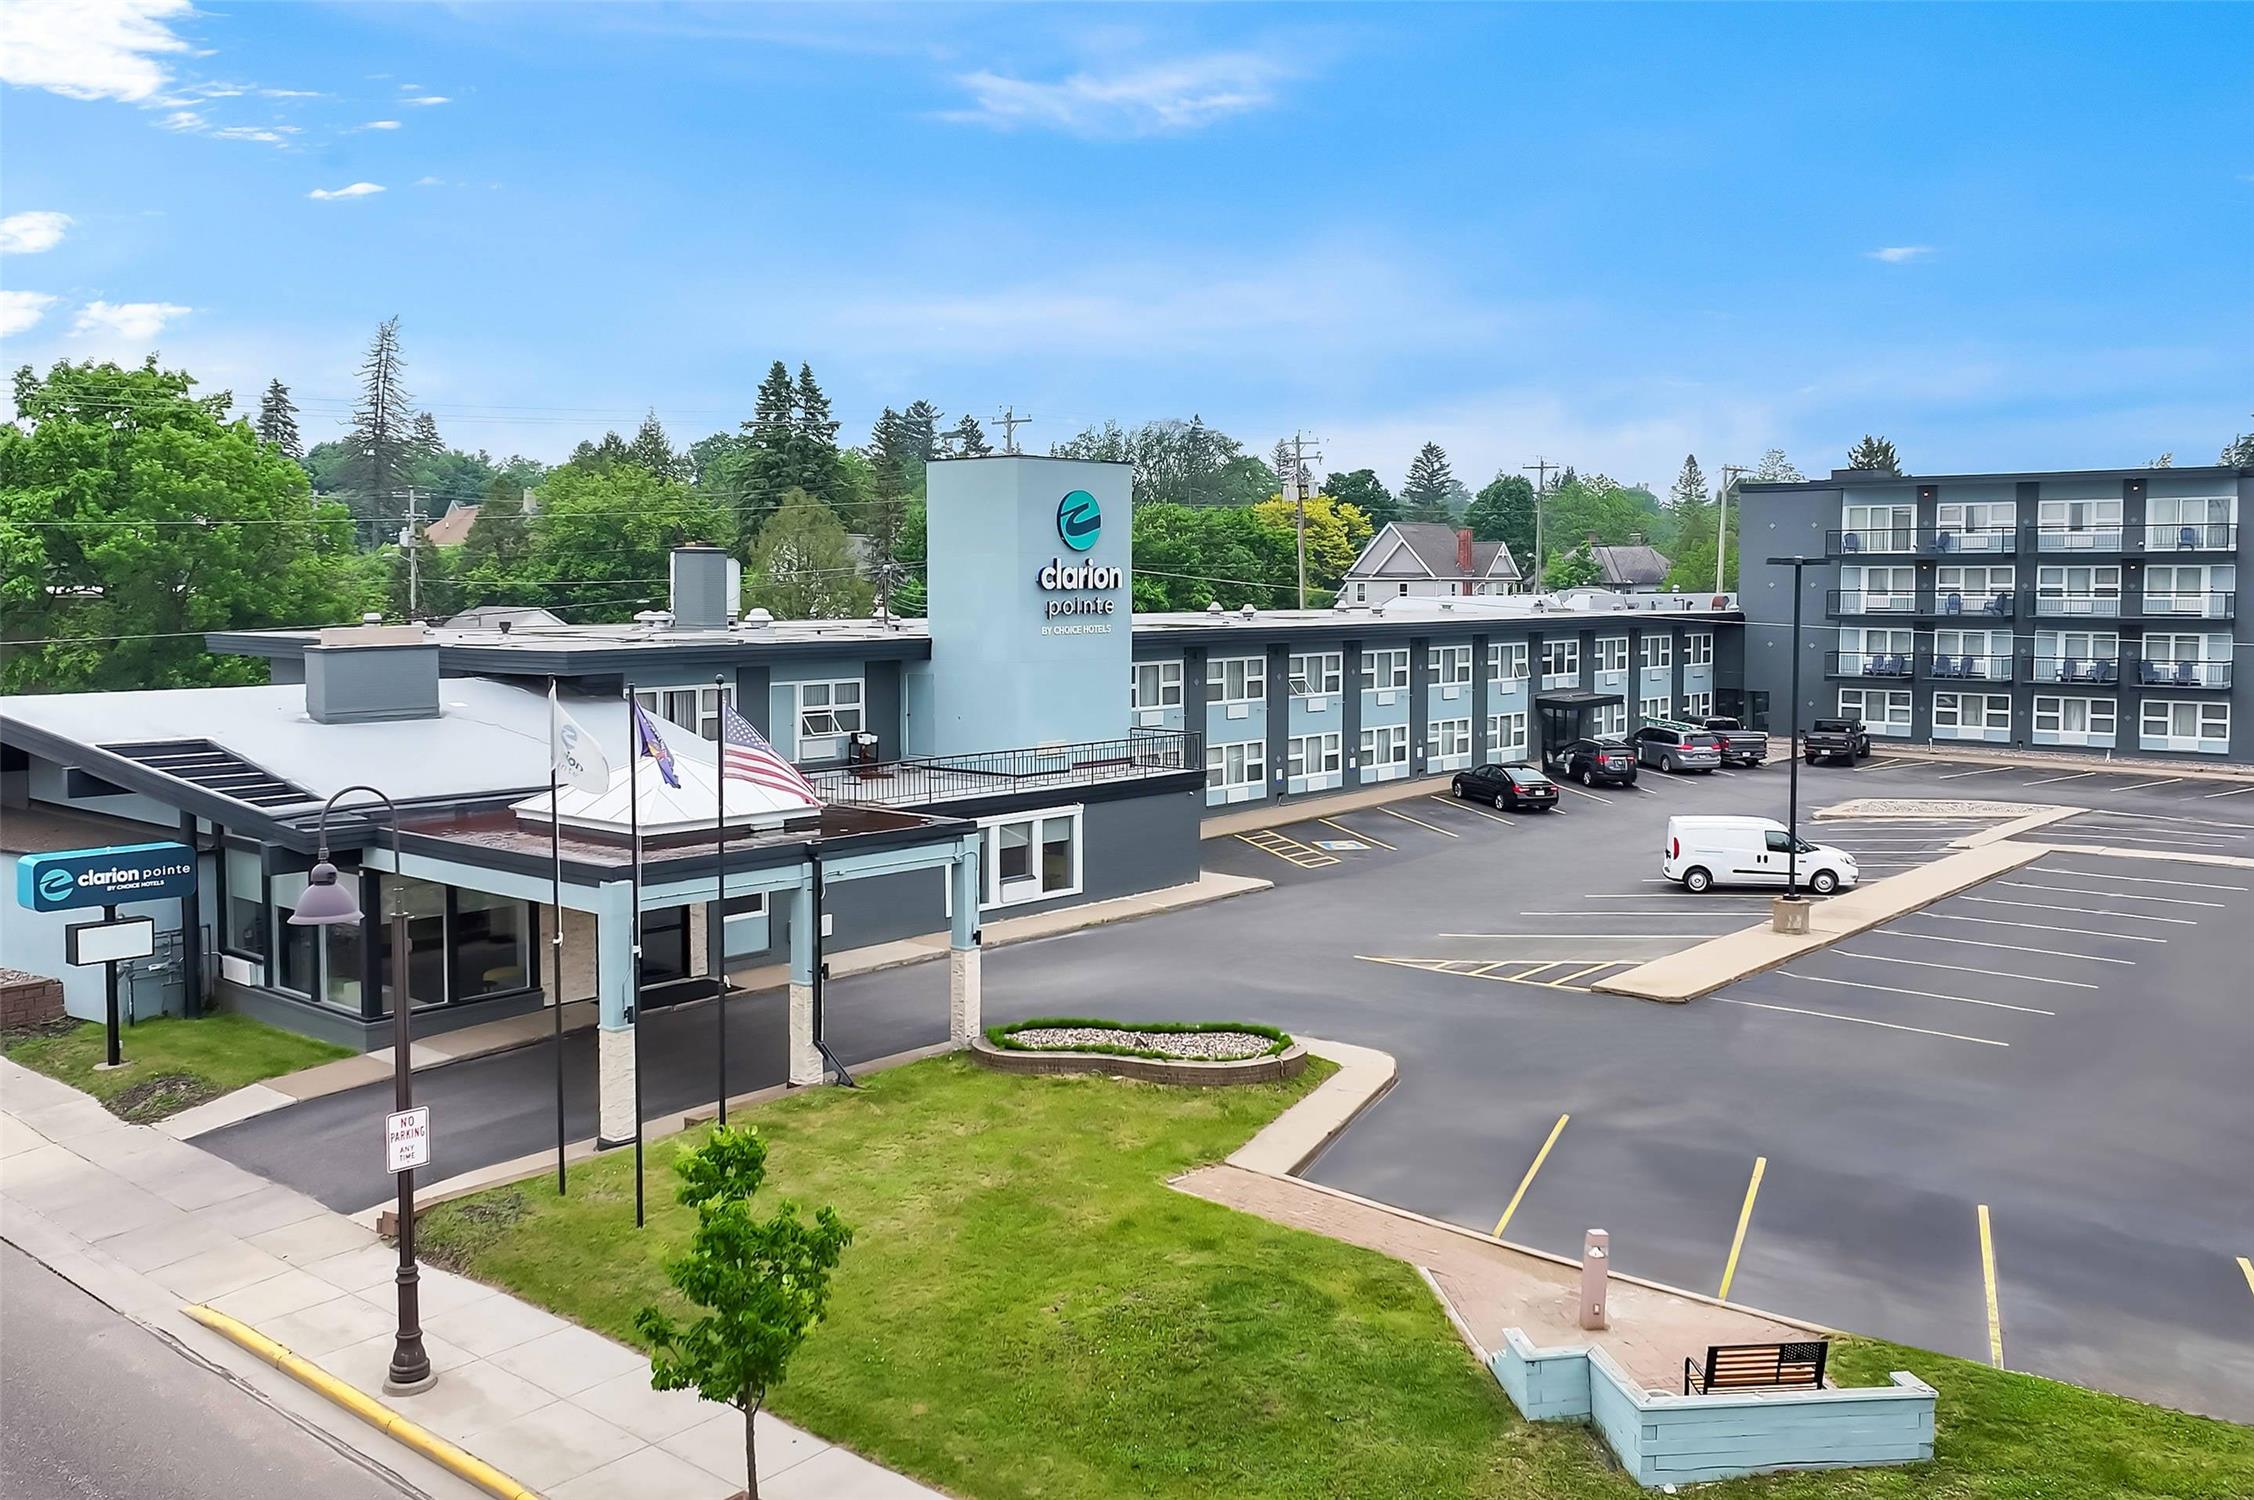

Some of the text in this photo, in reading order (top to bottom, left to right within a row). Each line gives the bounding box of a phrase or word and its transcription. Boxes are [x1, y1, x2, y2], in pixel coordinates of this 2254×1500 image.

[1039, 558, 1123, 590] clarion
[1047, 597, 1114, 619] pointe
[1041, 624, 1112, 636] BY CHOICE HOTELS
[78, 865, 190, 886] clarion pointe
[116, 882, 140, 890] CHOICE
[140, 880, 165, 888] HOTELS
[400, 1115, 415, 1128] NO
[390, 1126, 425, 1143] PARKING
[400, 1145, 415, 1153] ANY
[400, 1152, 415, 1161] TIME
